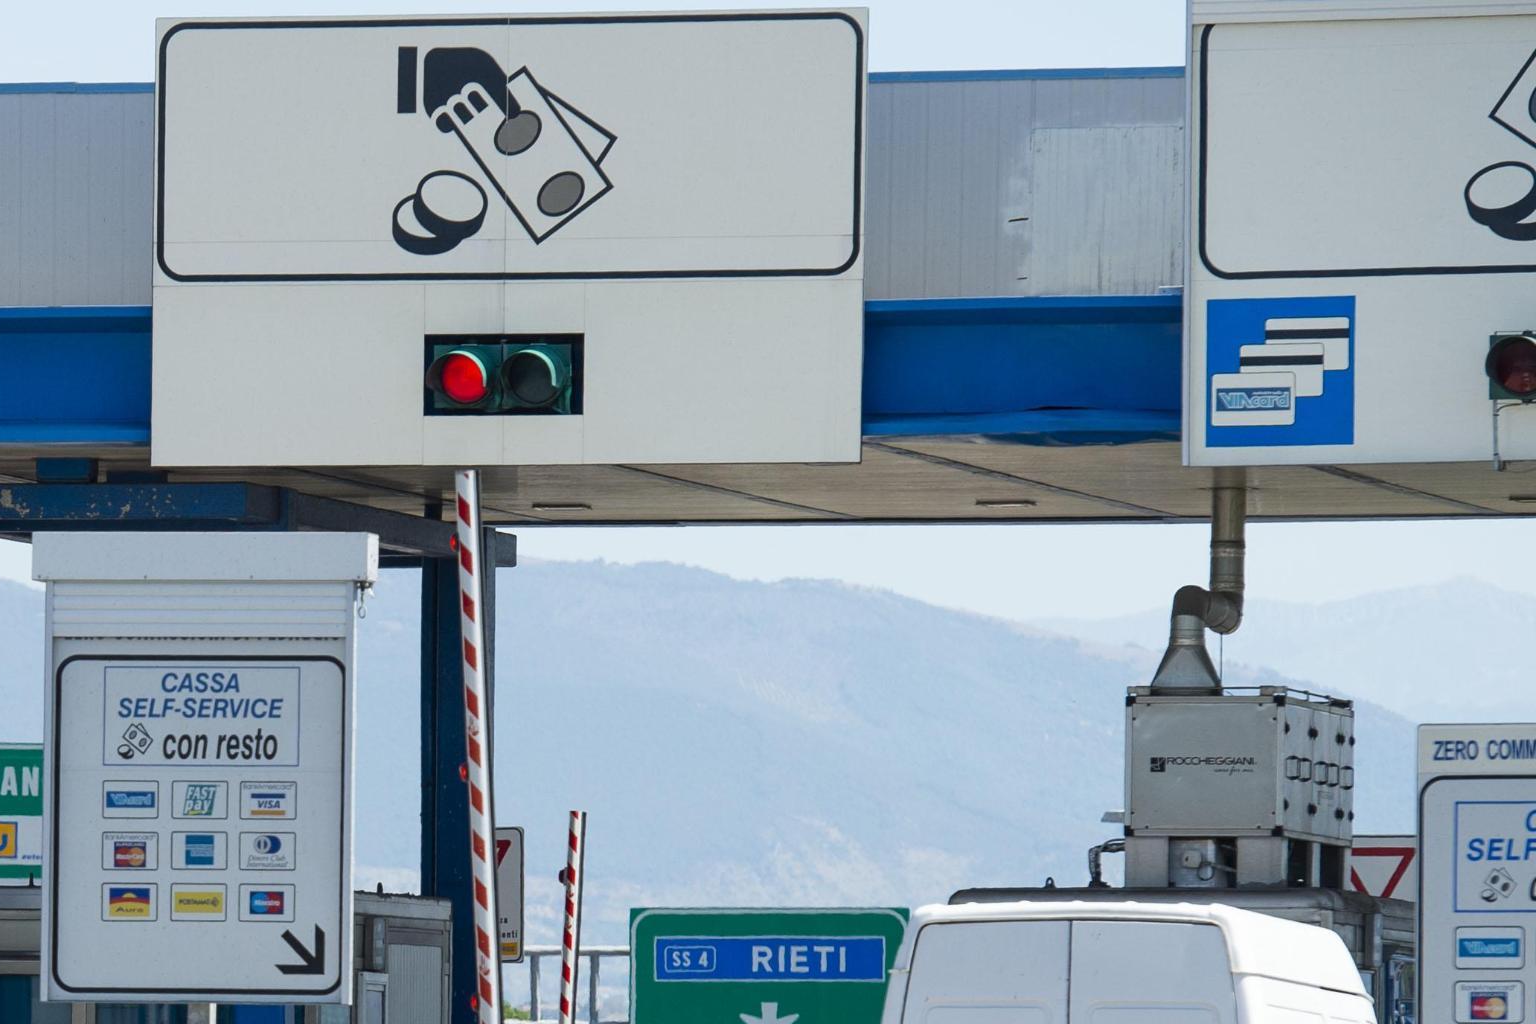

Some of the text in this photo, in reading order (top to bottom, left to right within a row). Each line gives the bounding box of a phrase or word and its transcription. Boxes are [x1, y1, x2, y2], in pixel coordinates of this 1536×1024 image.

[161, 673, 240, 693] CASSA
[118, 697, 284, 719] SELF-SERVICE
[162, 728, 278, 760] con resto
[1433, 740, 1479, 760] ZERO
[1167, 757, 1255, 766] ROCCHEGGIANI
[187, 786, 216, 800] FAST
[184, 799, 211, 815] pay
[257, 800, 281, 809] VISA
[672, 951, 709, 967] SS 4
[752, 946, 846, 973] RIETI
